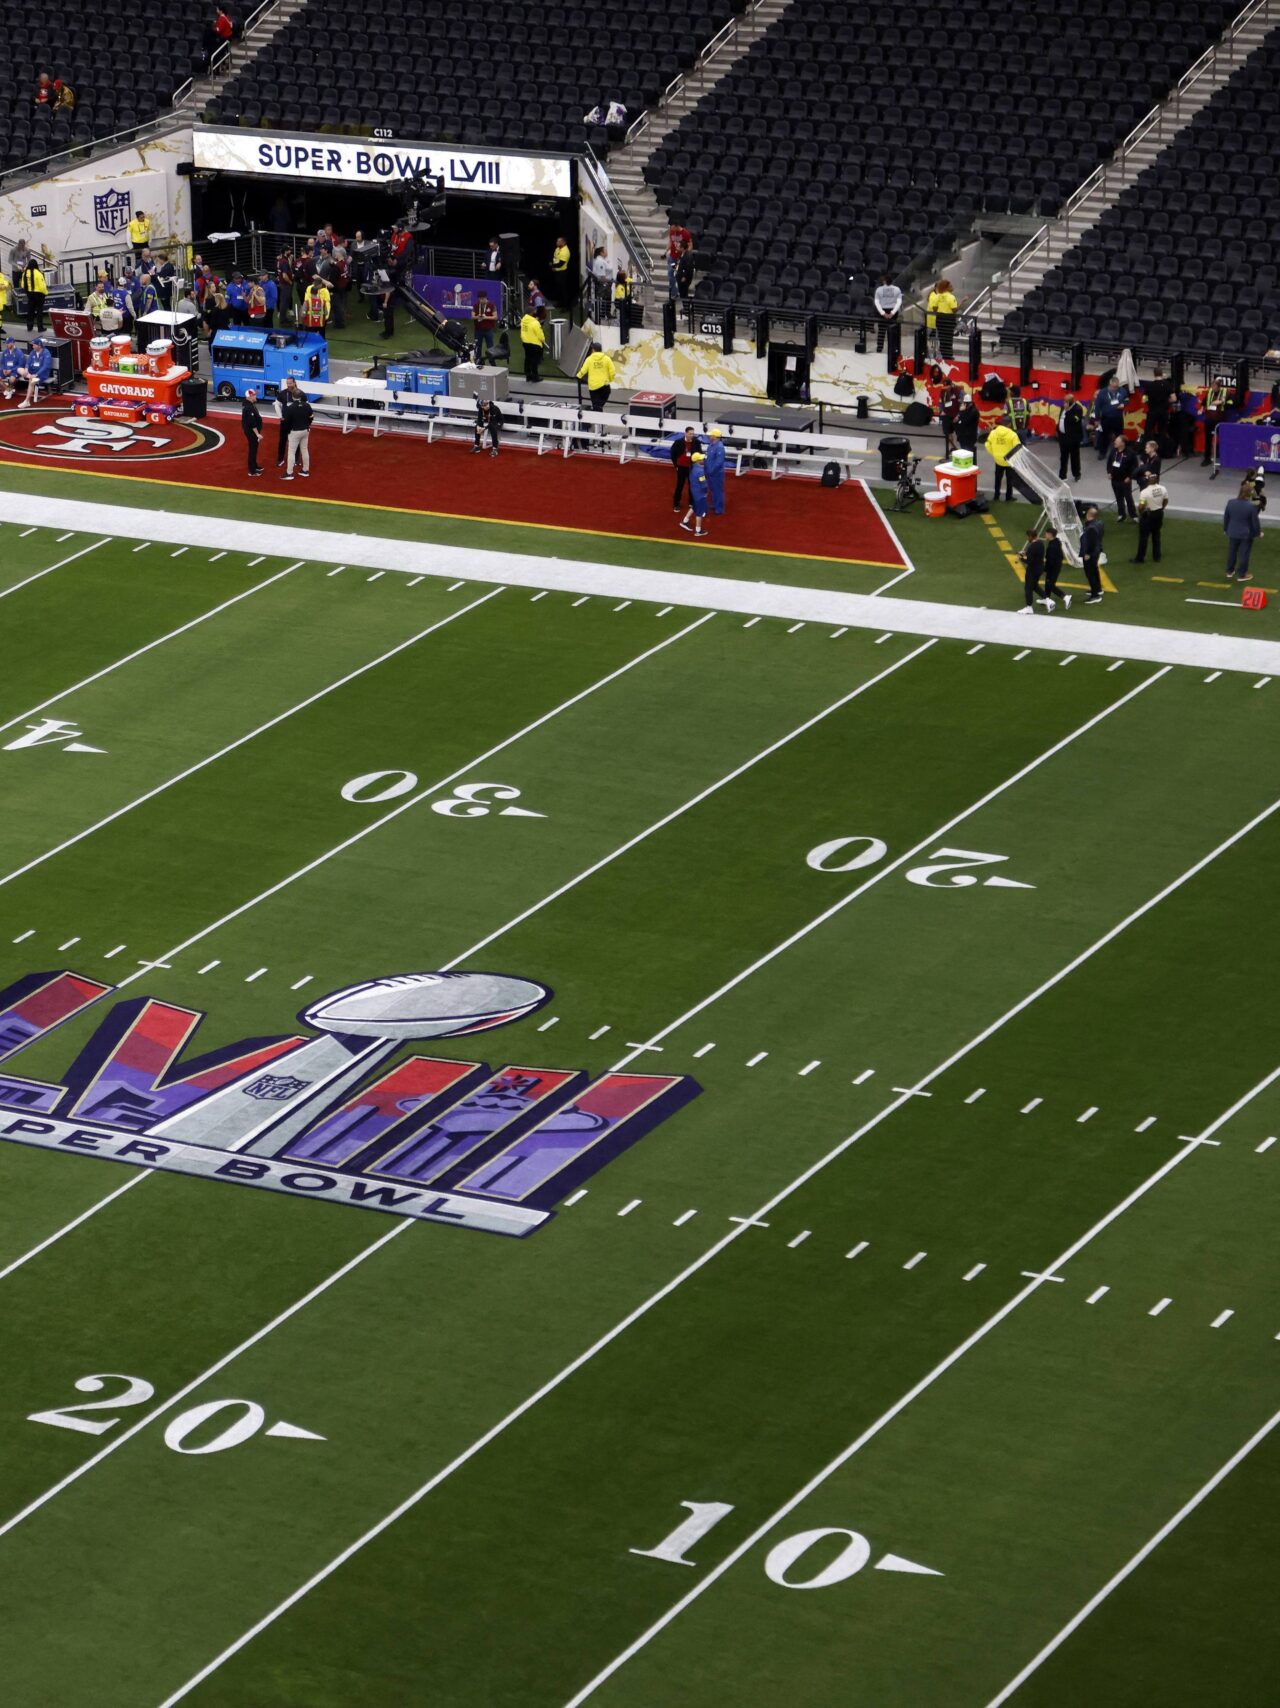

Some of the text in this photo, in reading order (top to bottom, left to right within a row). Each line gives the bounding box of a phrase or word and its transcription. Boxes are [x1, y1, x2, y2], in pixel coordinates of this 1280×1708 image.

[373, 128, 393, 137] C112
[259, 144, 500, 184] SUPER BOWL LVIII
[98, 206, 128, 229] NFL
[701, 323, 722, 333] C113
[92, 352, 100, 360] G
[99, 383, 155, 398] GATORADE
[80, 405, 88, 415] G
[103, 410, 129, 419] GATORADE
[151, 413, 159, 422] G
[939, 479, 952, 496] G
[340, 770, 522, 818] 30
[806, 836, 1011, 888] 20
[248, 1082, 289, 1098] NFL
[214, 1158, 465, 1220] BOWL
[26, 1373, 265, 1455] 20
[629, 1499, 872, 1589] 10
